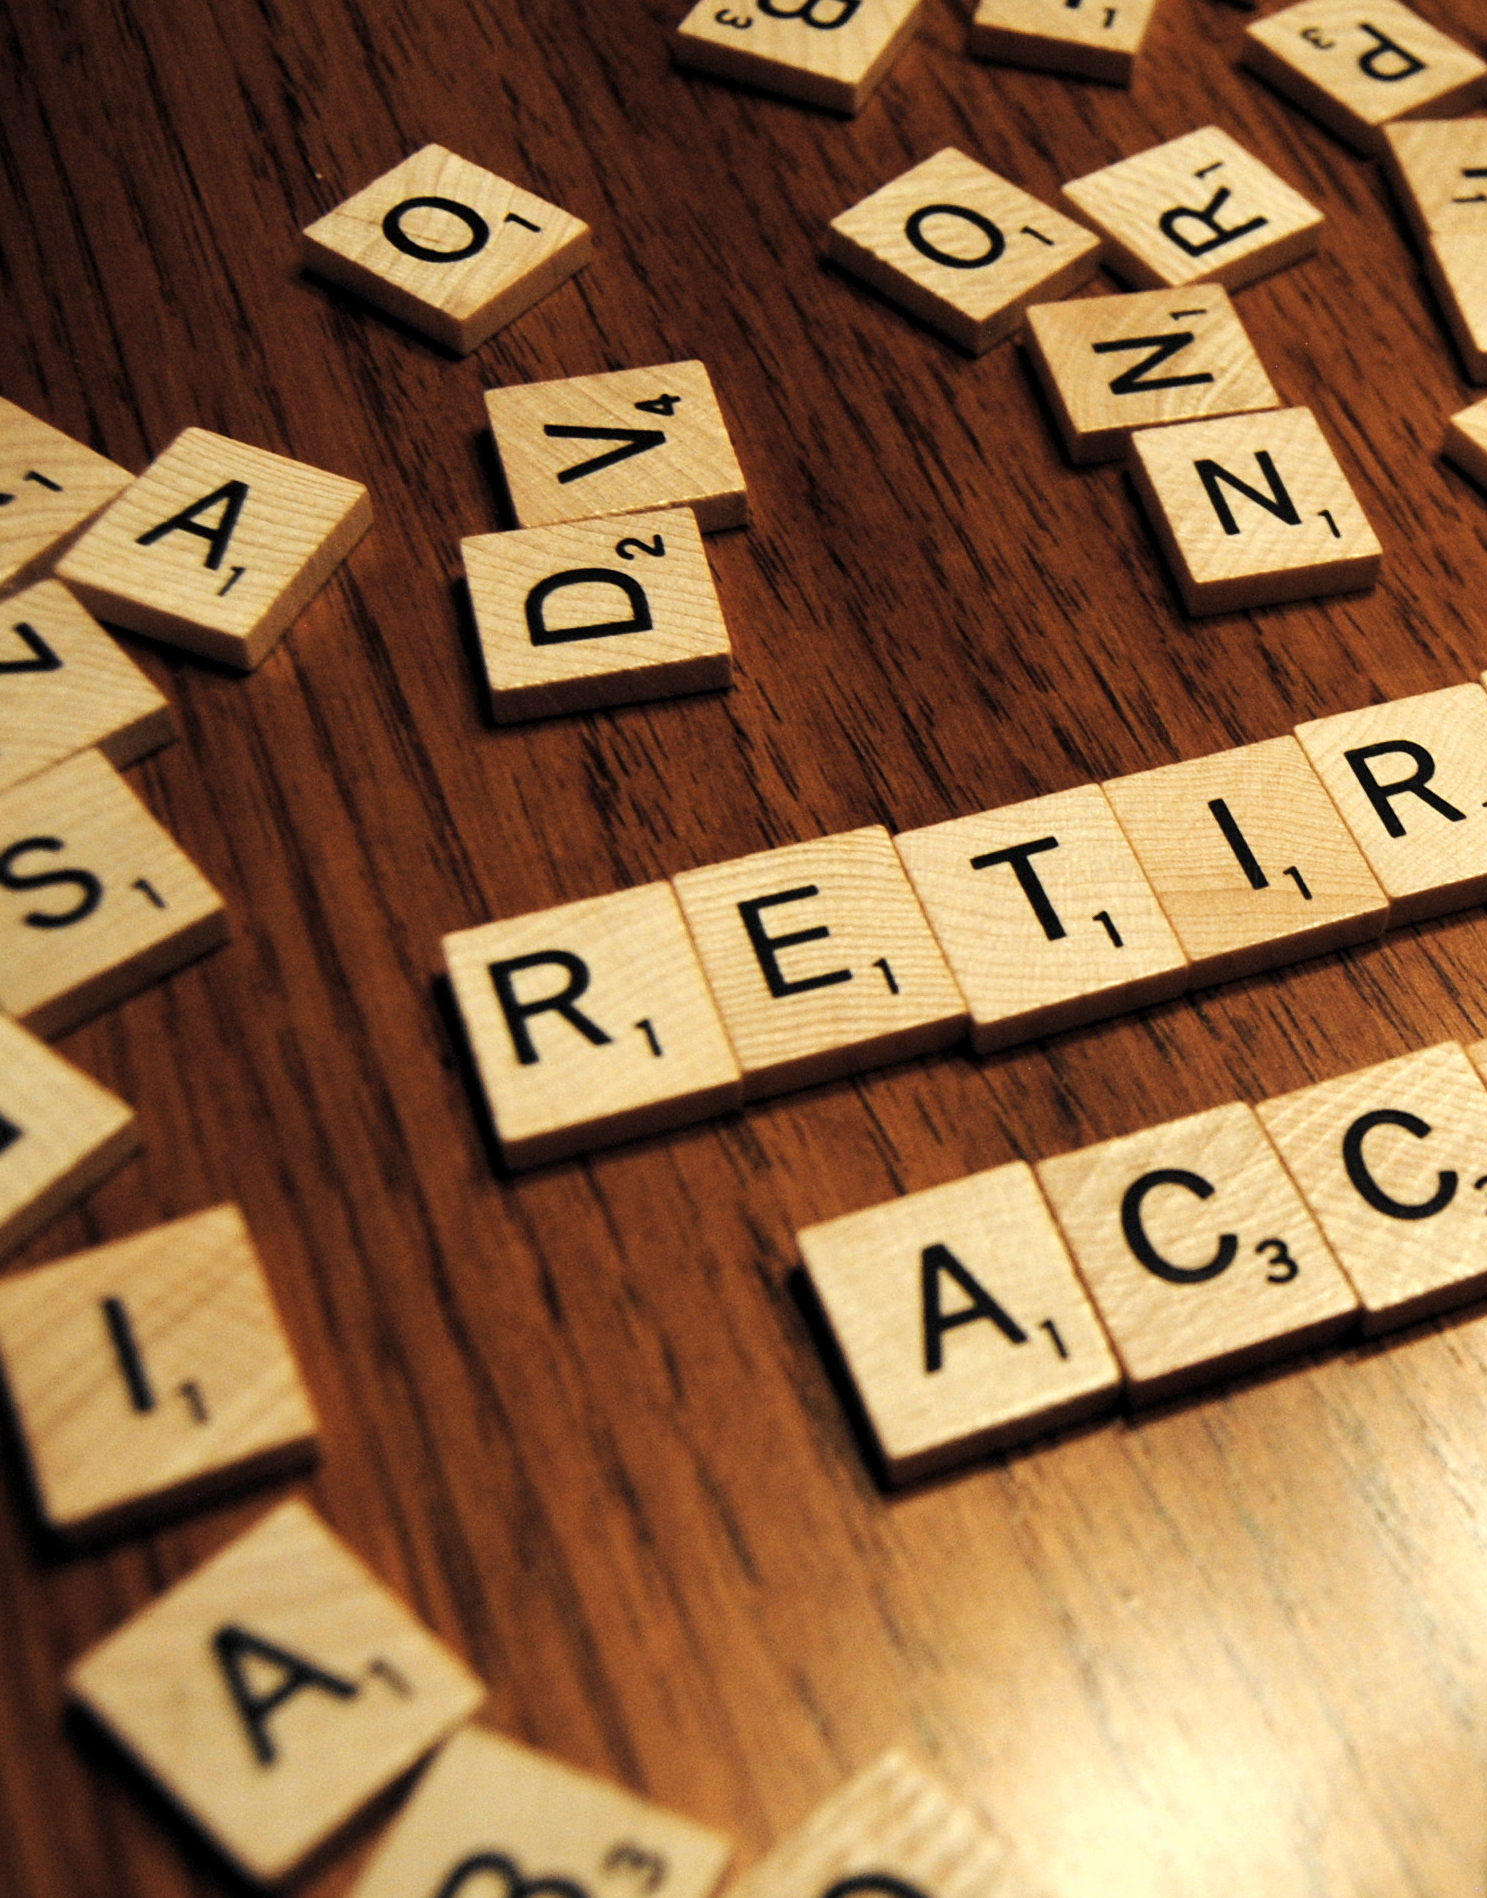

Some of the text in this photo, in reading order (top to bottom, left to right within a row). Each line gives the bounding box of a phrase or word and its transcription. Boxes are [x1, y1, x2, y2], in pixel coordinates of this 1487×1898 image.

[1357, 22, 1427, 83] P
[380, 195, 491, 264] O
[904, 203, 1007, 270] O
[1158, 186, 1269, 258] R
[1091, 331, 1215, 396] N
[543, 423, 667, 485] V
[135, 479, 250, 571] A
[1193, 450, 1302, 536] N
[523, 567, 654, 647] D
[0, 836, 103, 930] S
[99, 1296, 156, 1415] I
[209, 1624, 359, 1768] A
